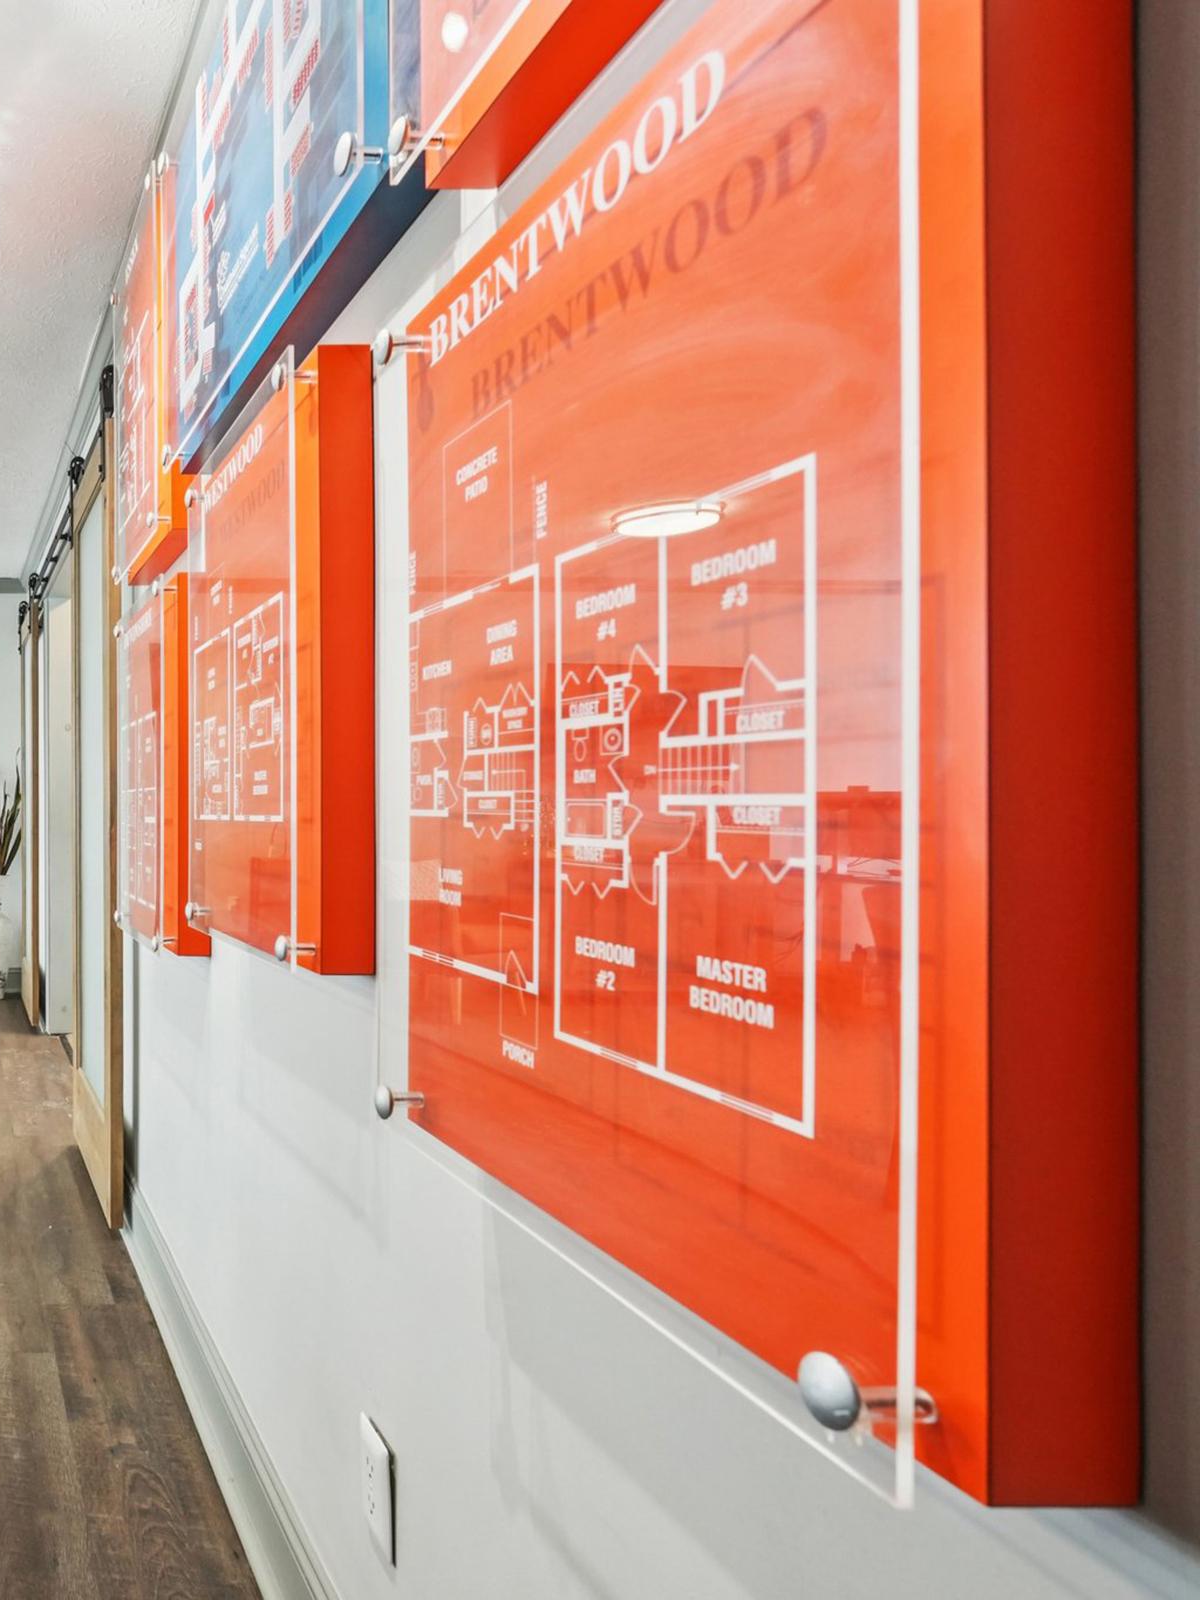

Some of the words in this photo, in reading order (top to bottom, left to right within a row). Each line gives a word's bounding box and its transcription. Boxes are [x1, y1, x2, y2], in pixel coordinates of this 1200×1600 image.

[429, 49, 726, 368] BRENTWOOD
[535, 480, 548, 539] FENCE
[690, 539, 777, 586] BEDROOM
[575, 583, 636, 619] BEDROOM
[720, 582, 749, 610] #3
[597, 618, 617, 641] #4
[569, 699, 600, 717] CLOSET
[736, 710, 785, 734] CLOSET
[733, 804, 781, 825] CLOSET
[574, 844, 604, 864] CLOSET
[575, 935, 635, 968] BEDROOM
[595, 970, 616, 992] #2
[696, 955, 767, 993] MASTER
[689, 985, 775, 1030] BEDROOM
[502, 1039, 535, 1070] PORCH
